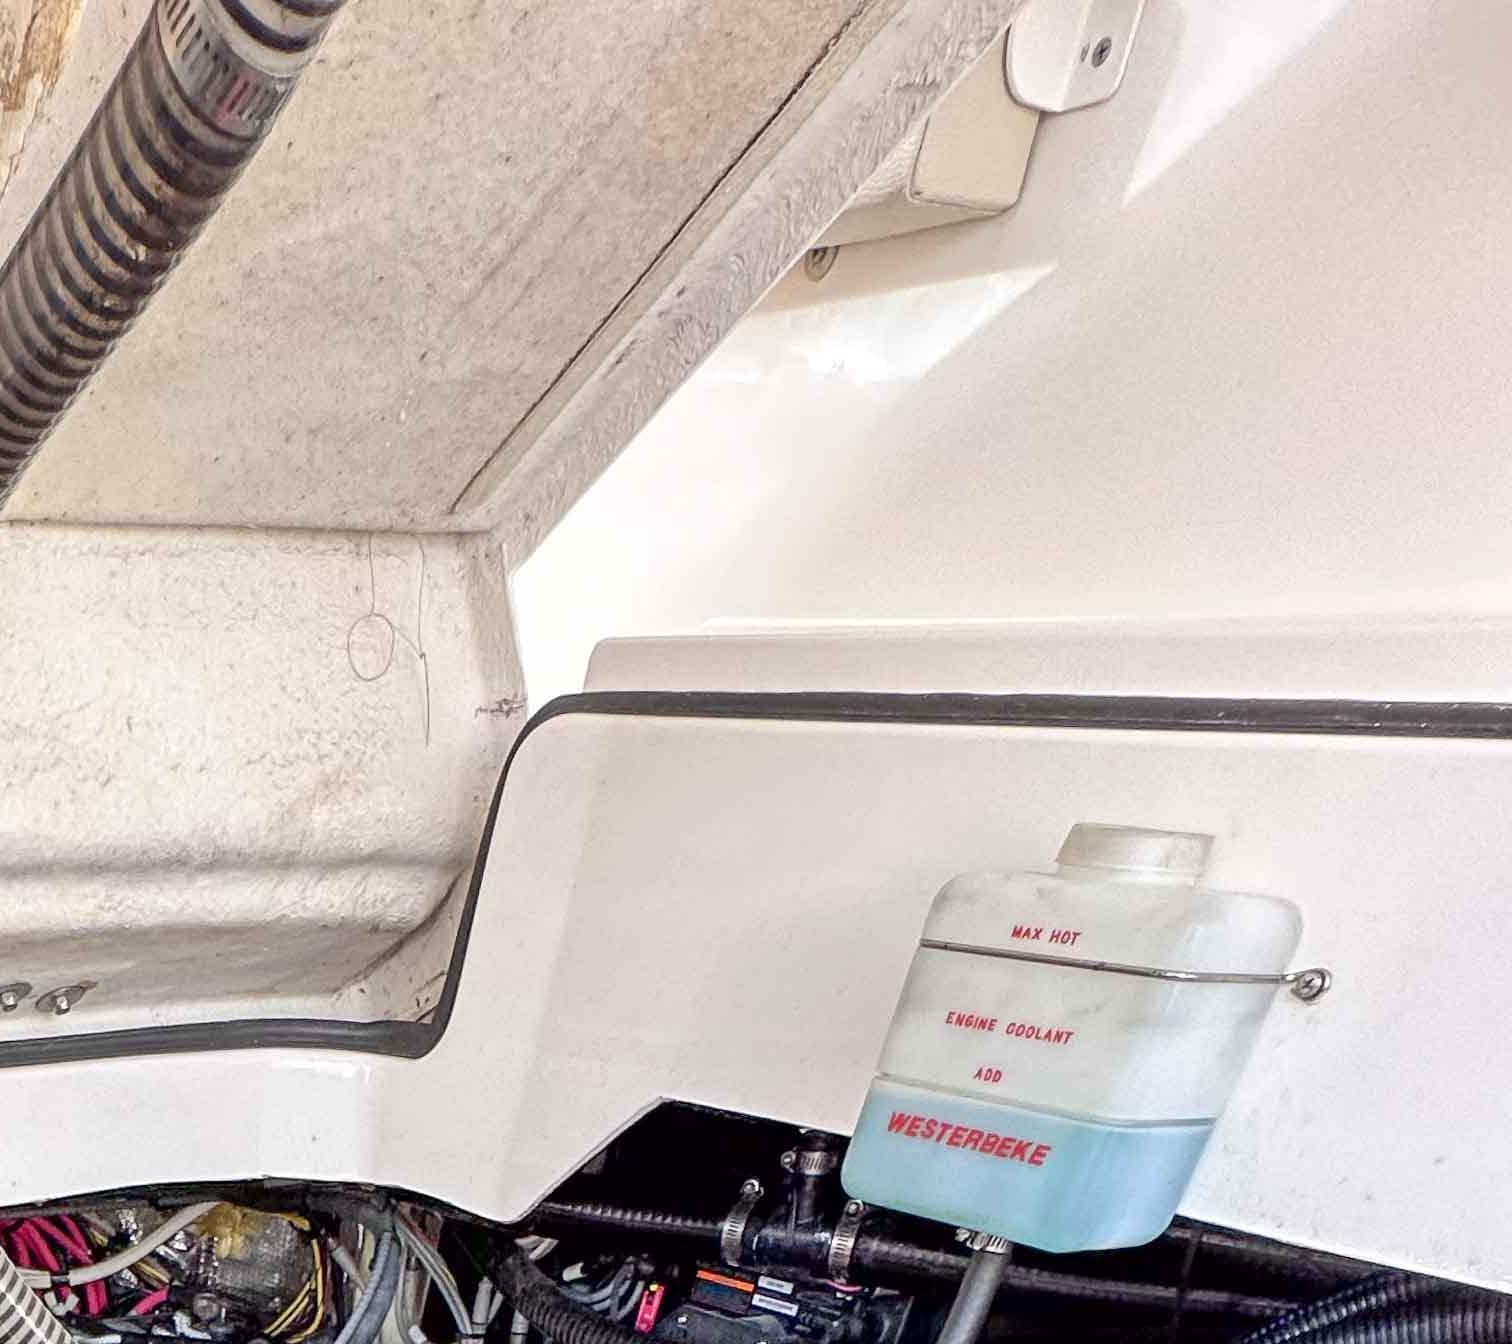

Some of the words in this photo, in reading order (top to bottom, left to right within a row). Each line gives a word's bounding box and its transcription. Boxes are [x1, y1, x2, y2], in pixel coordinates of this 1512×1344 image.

[1010, 925, 1043, 940] MAX
[1048, 929, 1082, 946] HOT
[945, 1011, 998, 1032] ENGINE
[1005, 1022, 1074, 1045] COOLANT
[973, 1067, 1002, 1083] ADD
[887, 1111, 1052, 1166] WESTERBEKE
